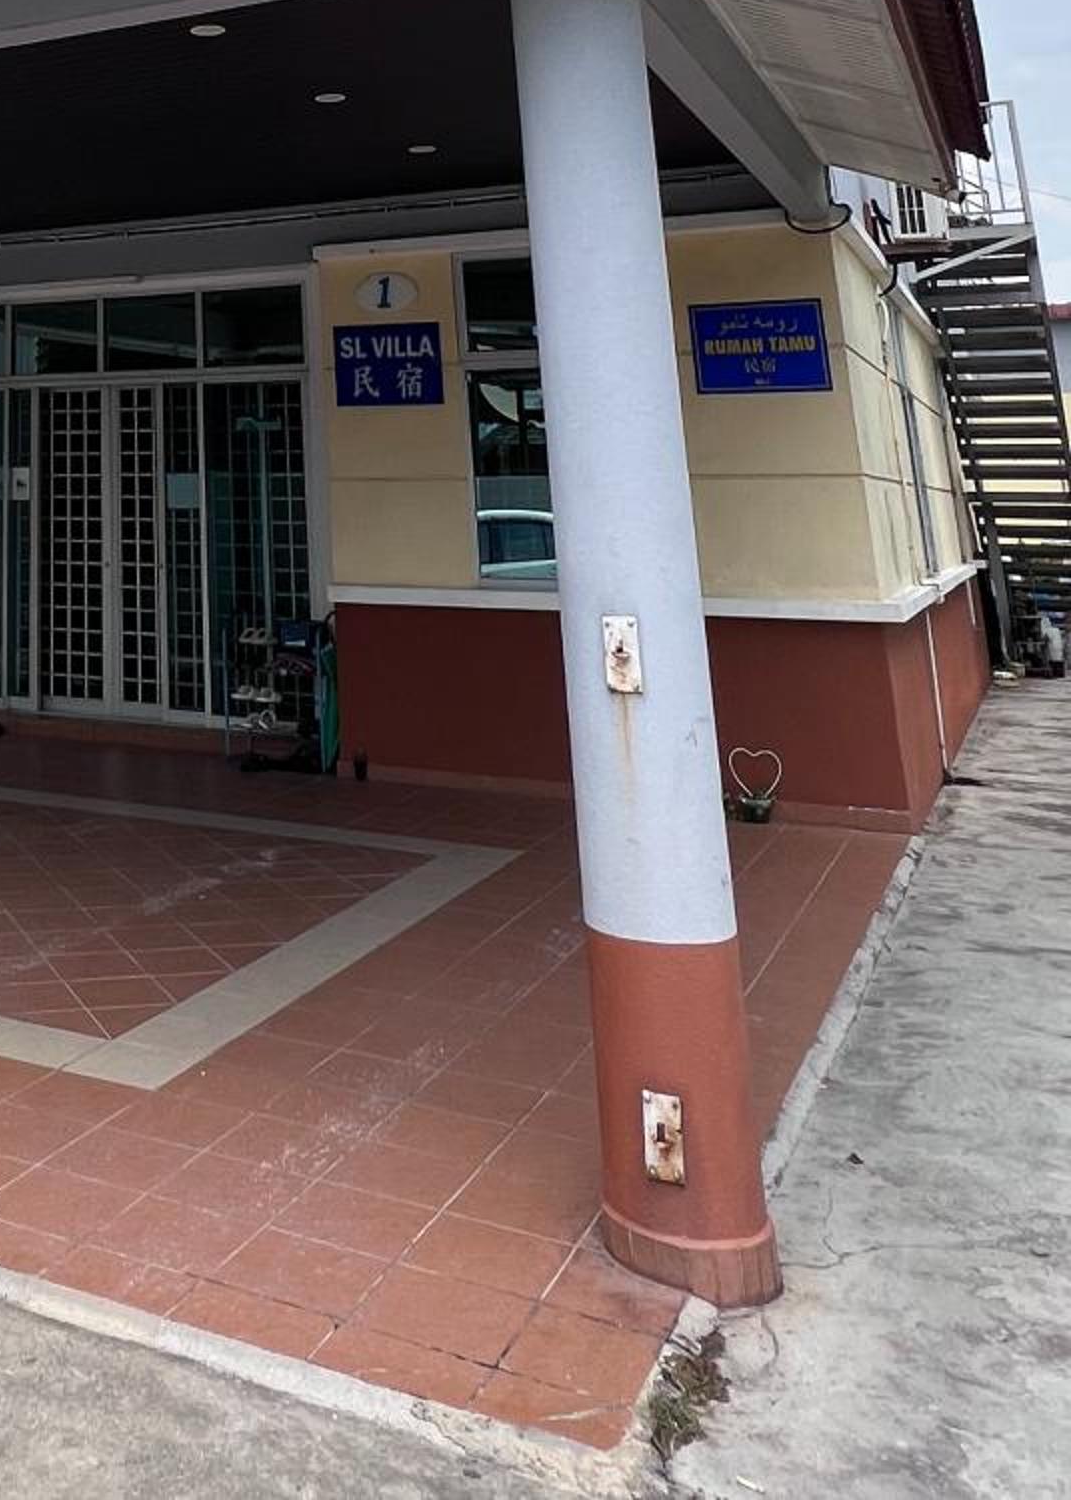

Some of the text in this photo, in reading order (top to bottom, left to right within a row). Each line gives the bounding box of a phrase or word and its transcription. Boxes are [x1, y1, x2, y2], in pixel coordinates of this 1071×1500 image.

[377, 276, 391, 308] 1
[340, 335, 434, 359] SL VILLA
[704, 335, 816, 356] RUMAH TAMU
[353, 363, 424, 399] 民宿
